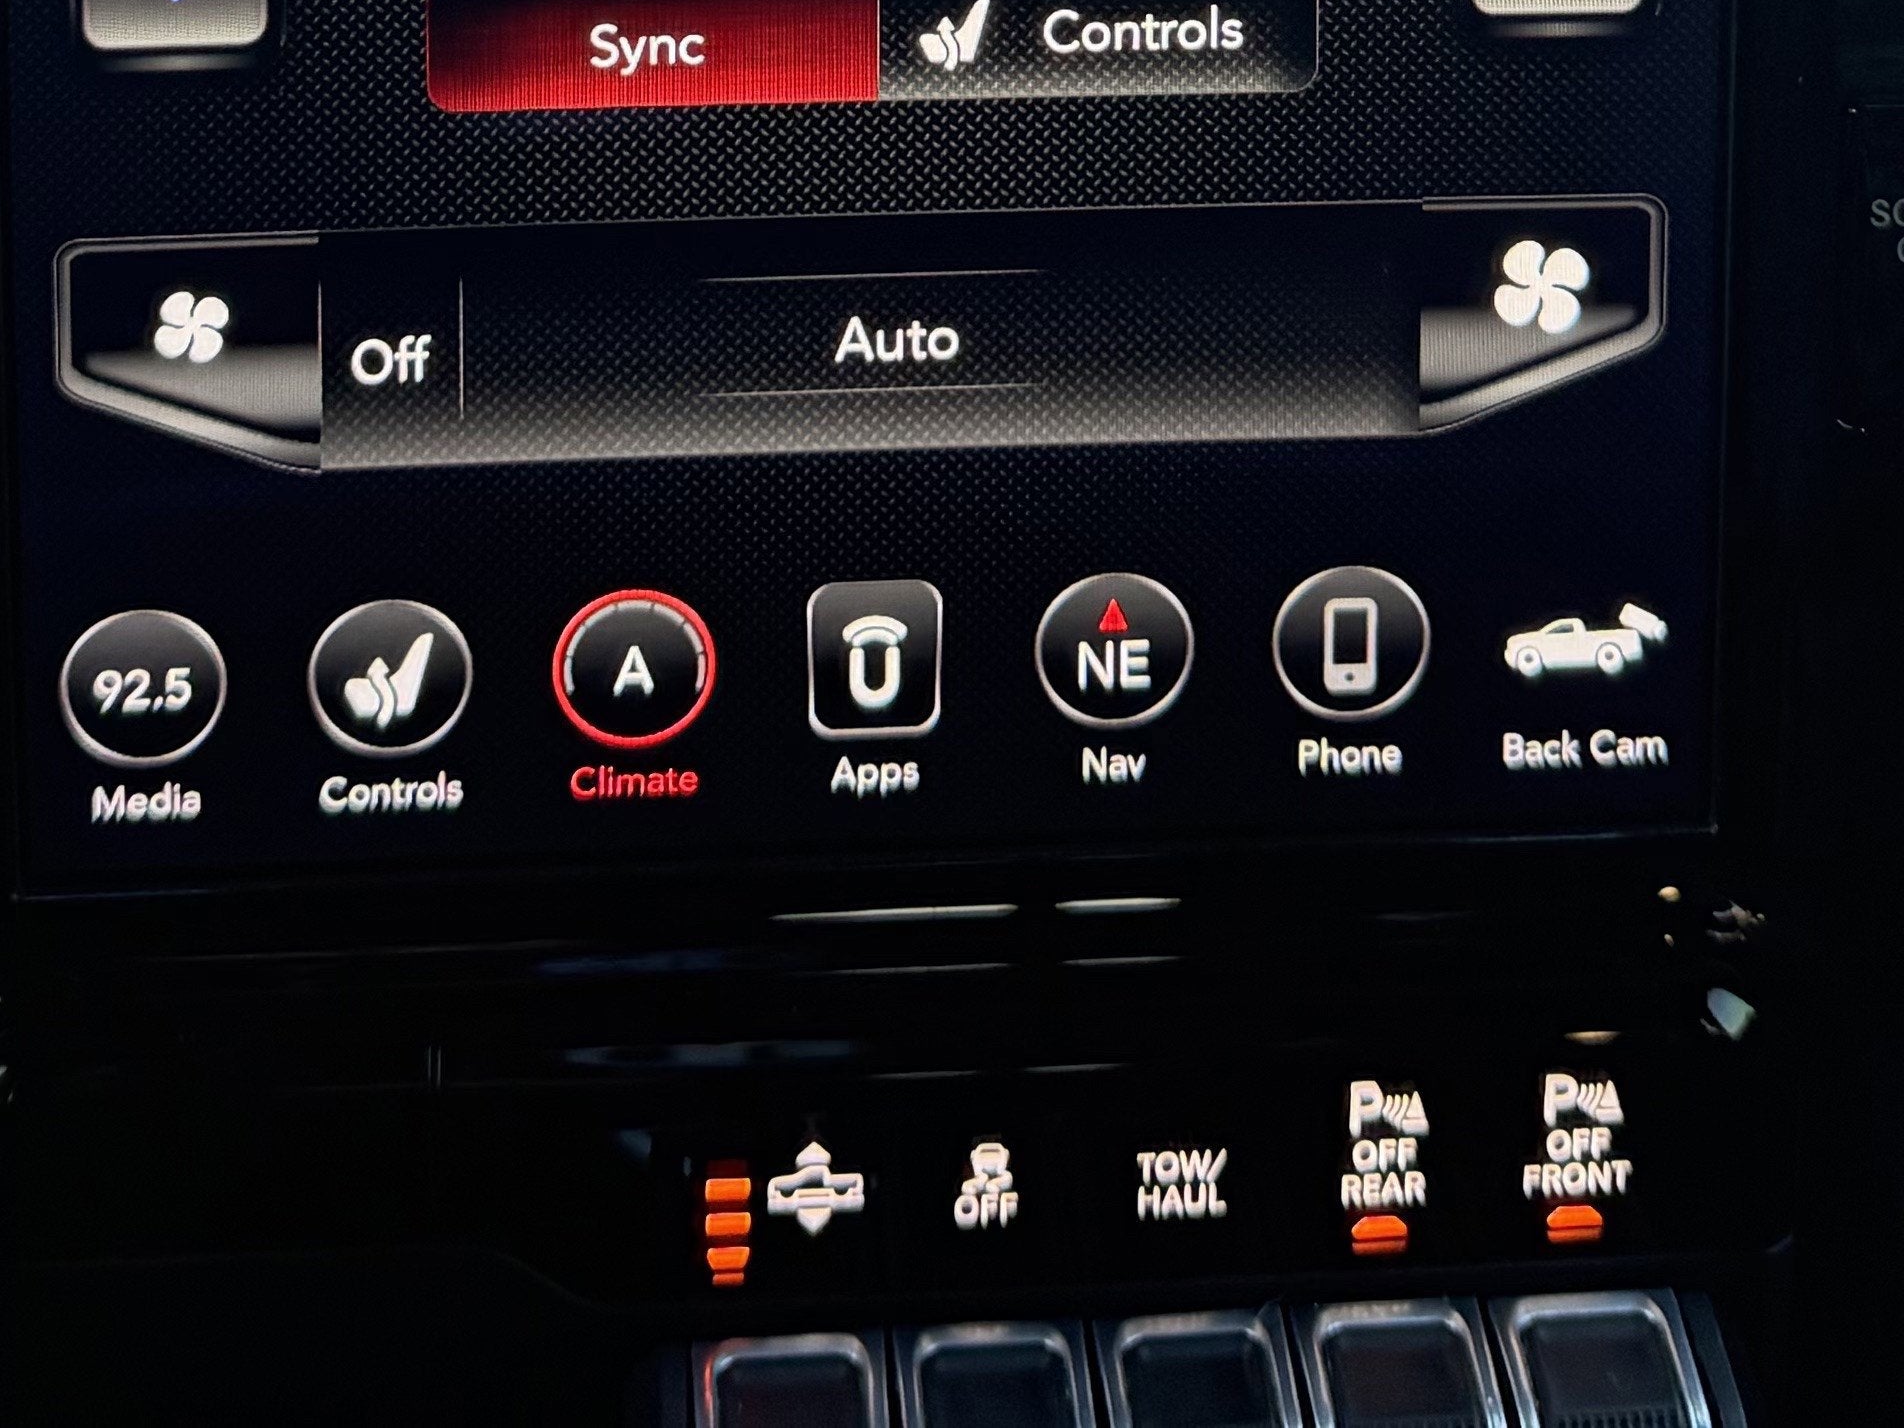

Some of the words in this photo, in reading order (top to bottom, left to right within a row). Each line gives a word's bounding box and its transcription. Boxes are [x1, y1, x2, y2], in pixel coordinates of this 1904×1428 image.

[1042, 4, 1245, 54] Controls
[590, 23, 705, 77] Sync
[834, 315, 960, 364] Auto
[350, 334, 432, 386] Off
[613, 645, 654, 696] A
[1077, 638, 1151, 690] NE
[93, 667, 192, 713] 92.5
[1082, 746, 1146, 782] Nav
[1298, 737, 1402, 774] Phone
[1502, 729, 1581, 768] Back
[1589, 729, 1667, 765] Cam
[318, 770, 464, 813] Controls
[570, 766, 699, 800] Climate
[830, 755, 920, 796] Apps
[91, 781, 202, 821] Media
[1137, 1148, 1227, 1181] TOW/
[1353, 1138, 1418, 1172] OFF
[1546, 1128, 1612, 1163] OFF
[1341, 1171, 1426, 1206] REAR
[1523, 1160, 1631, 1196] FRONT
[953, 1191, 1018, 1228] OFF
[1137, 1183, 1226, 1217] HAUL
